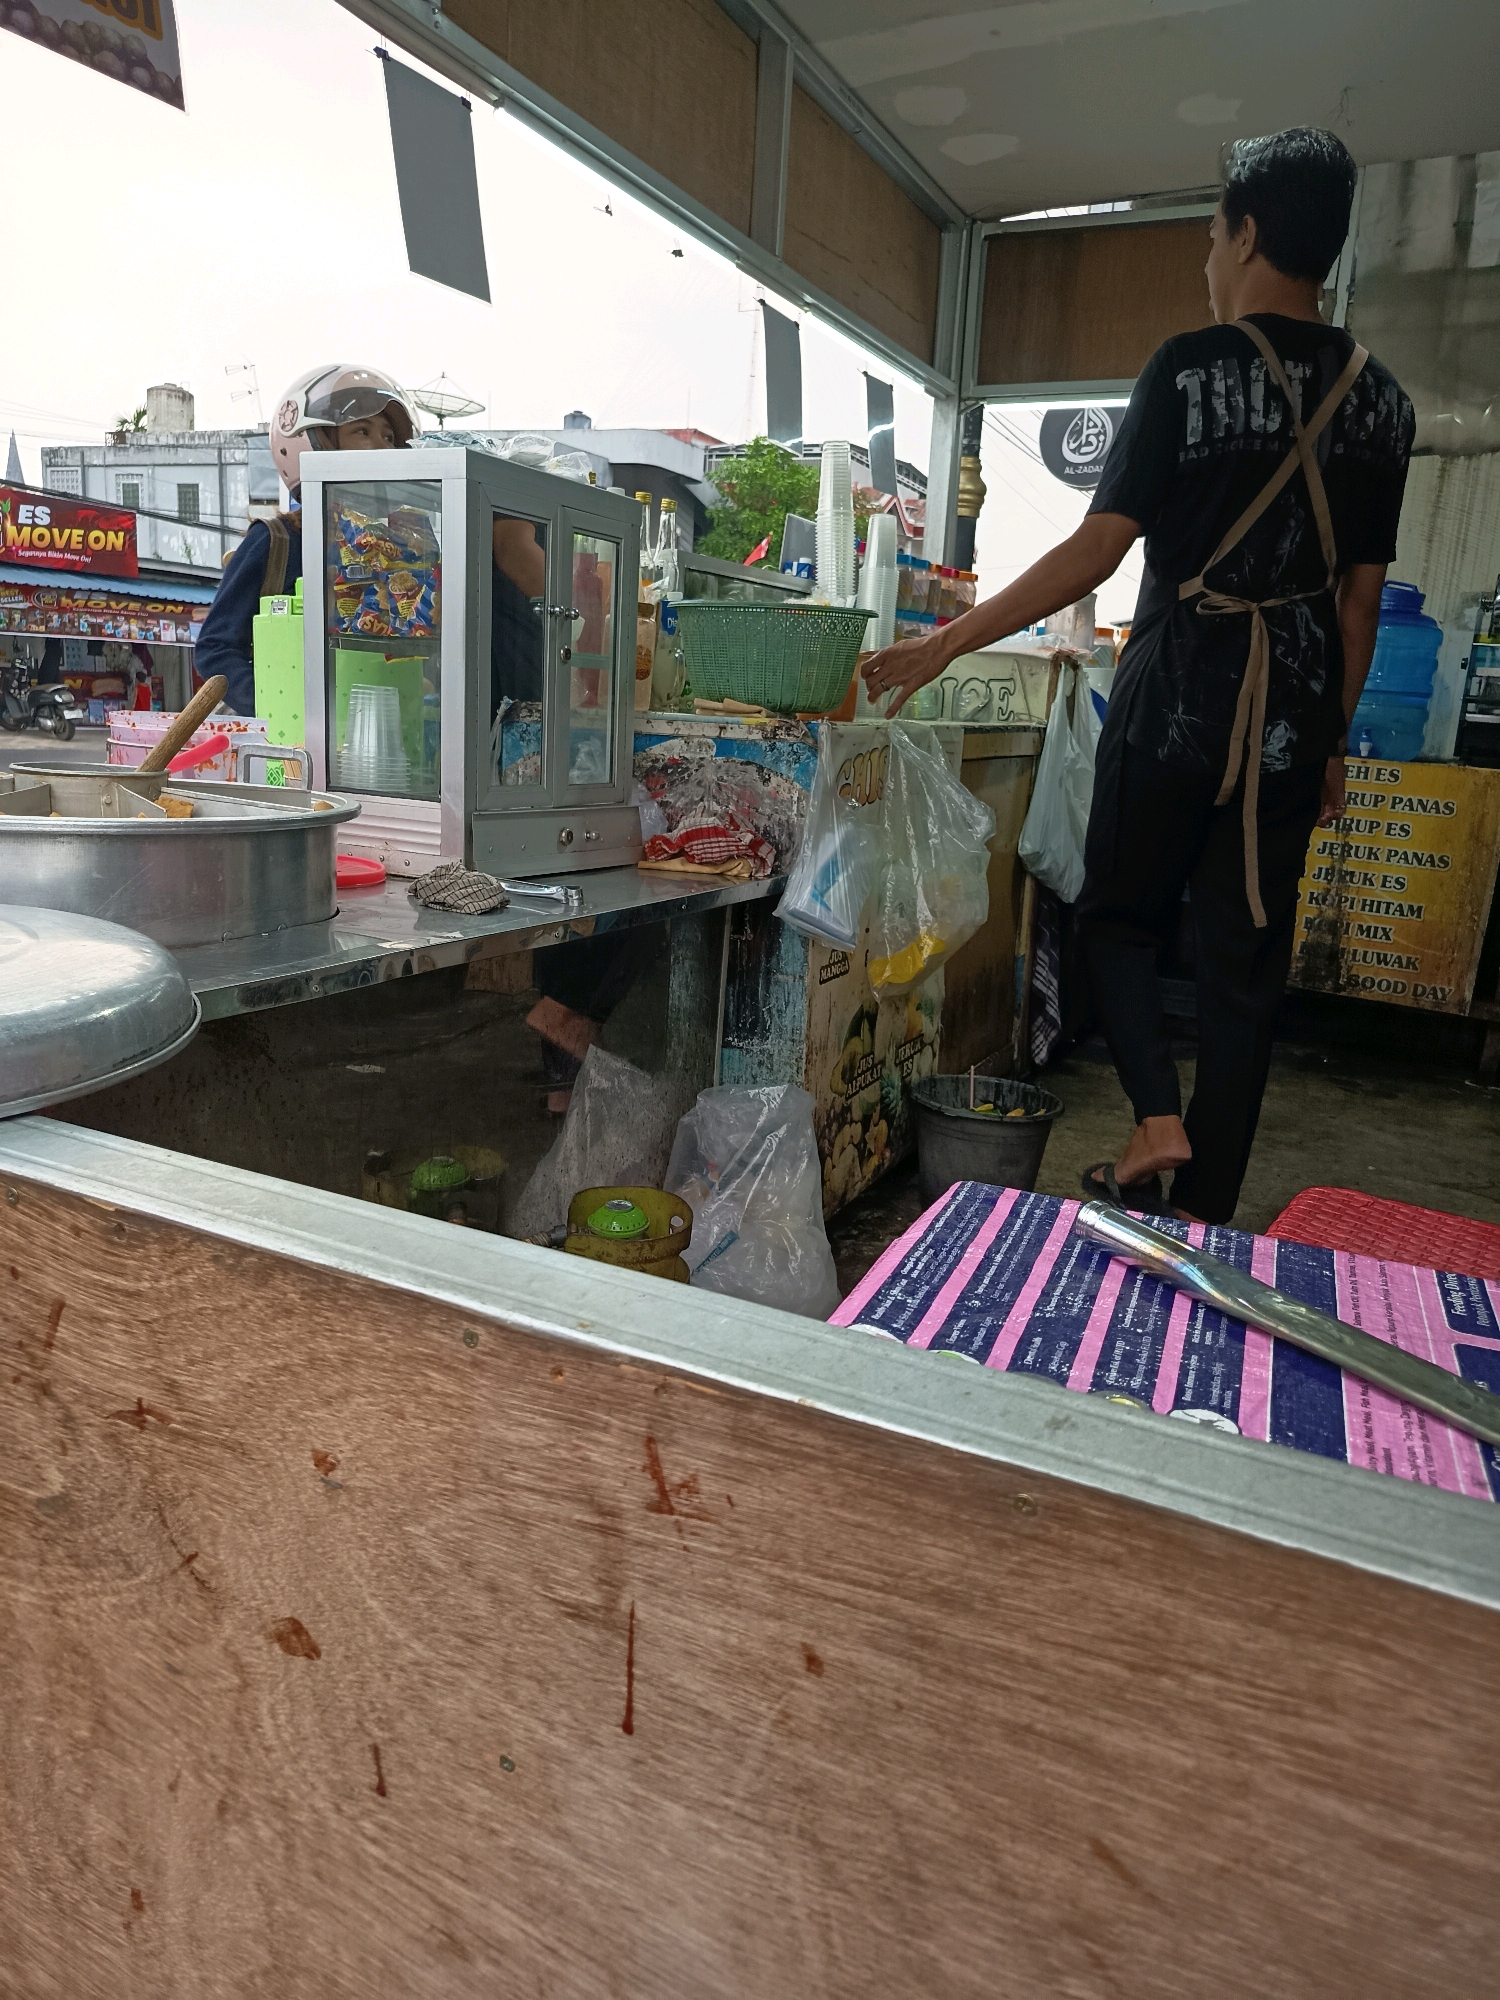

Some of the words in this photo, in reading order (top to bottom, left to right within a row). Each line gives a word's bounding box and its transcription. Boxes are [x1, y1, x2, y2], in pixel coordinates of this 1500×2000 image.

[18, 504, 51, 526] ES
[6, 525, 84, 550] MOVE
[87, 530, 125, 552] ON
[64, 552, 80, 562] Move
[60, 598, 142, 611] MOVE
[145, 604, 184, 614] ON
[1346, 765, 1369, 781] EH
[1374, 767, 1401, 784] ES
[1347, 792, 1386, 809] RUP
[1390, 797, 1456, 816] PANAS
[1385, 822, 1411, 838] ES
[1317, 842, 1381, 862] JERUK
[1385, 850, 1451, 869] PANAS
[1380, 875, 1407, 891] ES
[1360, 898, 1424, 919] HITAM
[1354, 924, 1394, 942] MIX
[829, 950, 843, 963] JUS
[1351, 949, 1420, 972] LUWAK
[821, 960, 849, 980] MANGGA
[1411, 982, 1453, 1003] DAY
[857, 1054, 874, 1075] JUS
[903, 1060, 913, 1077] ES
[846, 1065, 882, 1097] ALPUKAT
[1448, 1291, 1466, 1316] Feeding
[1364, 1425, 1373, 1440] Meat
